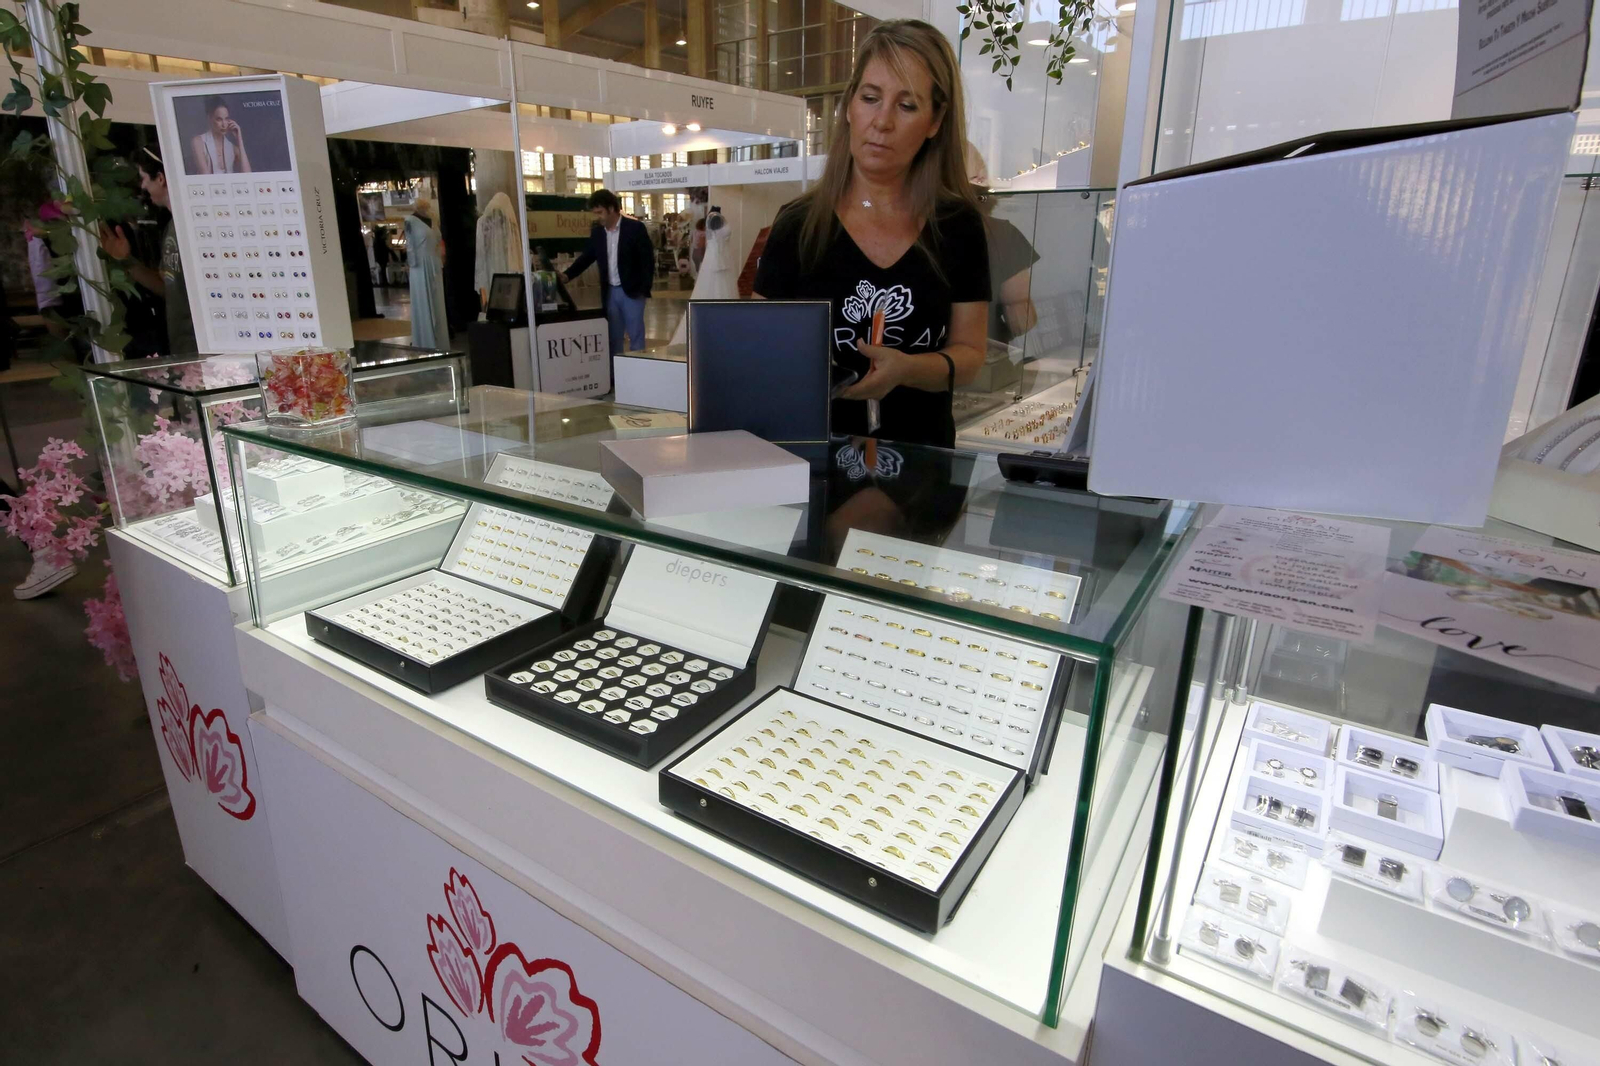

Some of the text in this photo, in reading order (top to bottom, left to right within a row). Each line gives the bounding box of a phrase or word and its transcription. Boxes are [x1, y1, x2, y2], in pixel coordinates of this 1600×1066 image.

[691, 94, 714, 110] RUYFE
[631, 179, 661, 187] COMPLEMENTOS
[660, 176, 688, 184] ARTESANALES
[754, 166, 789, 176] HALCON VIAJES
[313, 186, 328, 255] VICTORIA CRUZ
[665, 558, 729, 588] diepers
[1188, 578, 1355, 614] www.joyeriaorisan.com
[350, 944, 500, 1066] OR
